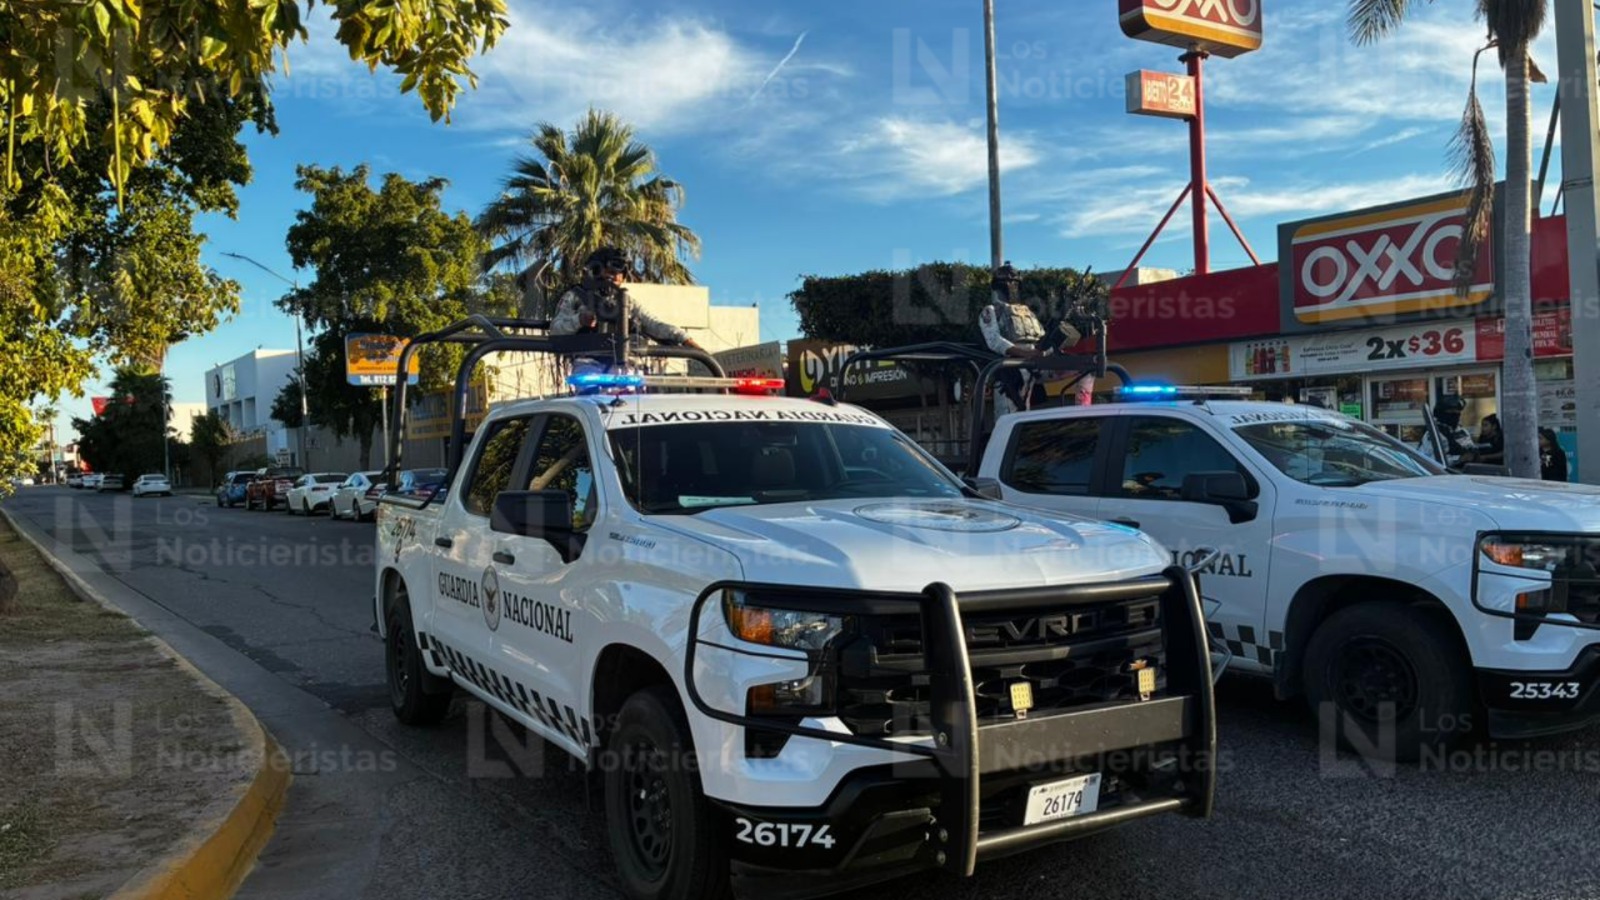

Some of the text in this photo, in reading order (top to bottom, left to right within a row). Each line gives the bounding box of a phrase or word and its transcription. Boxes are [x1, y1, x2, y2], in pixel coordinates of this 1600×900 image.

[1169, 78, 1192, 101] 24
[438, 571, 573, 644] GUARDIA NACIONAL
[1509, 682, 1580, 701] 25343
[736, 817, 836, 850] 26174
